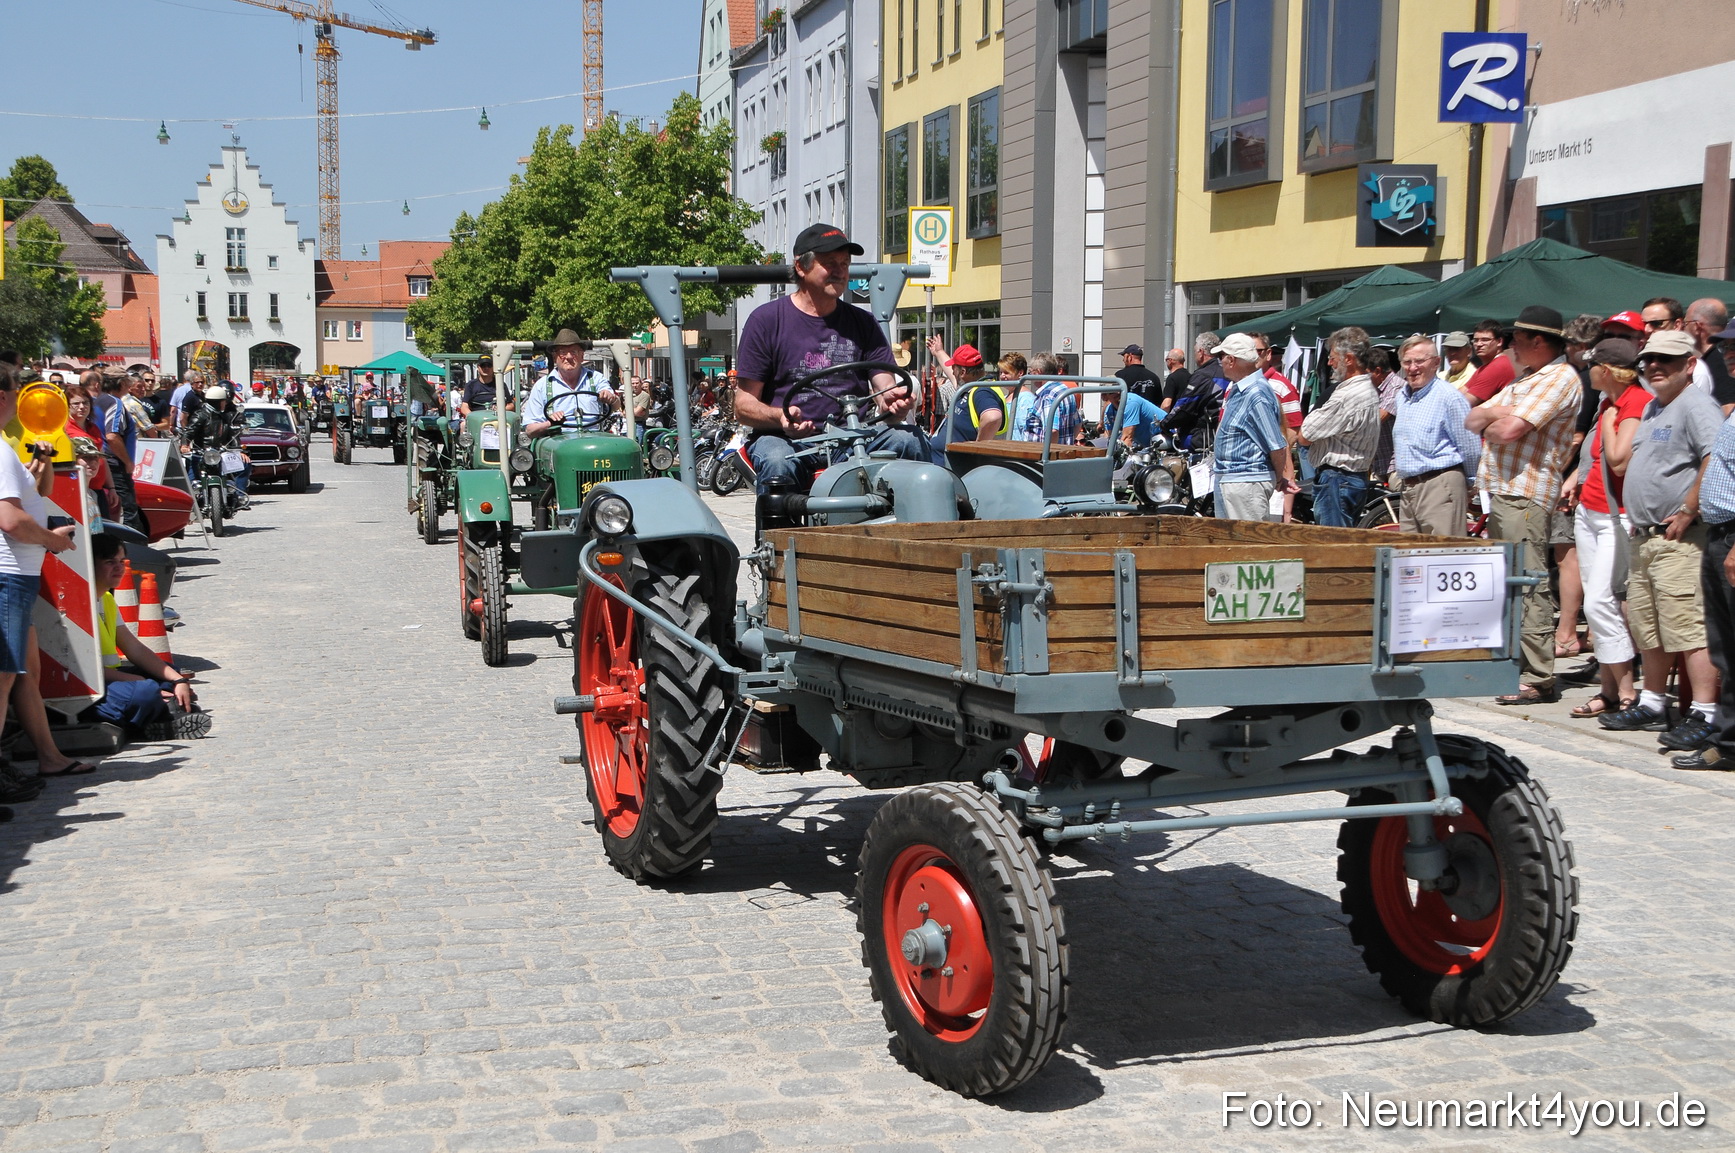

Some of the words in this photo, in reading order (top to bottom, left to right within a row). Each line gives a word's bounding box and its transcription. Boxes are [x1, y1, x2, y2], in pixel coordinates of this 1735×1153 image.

[1529, 149, 1557, 165] Unterer
[1558, 142, 1581, 159] Markt
[1583, 138, 1593, 155] 15
[1390, 187, 1417, 220] G2
[924, 220, 938, 238] H
[1237, 565, 1275, 590] NM
[1437, 571, 1477, 592] 383
[1211, 593, 1248, 618] AH
[1258, 592, 1300, 616] 742
